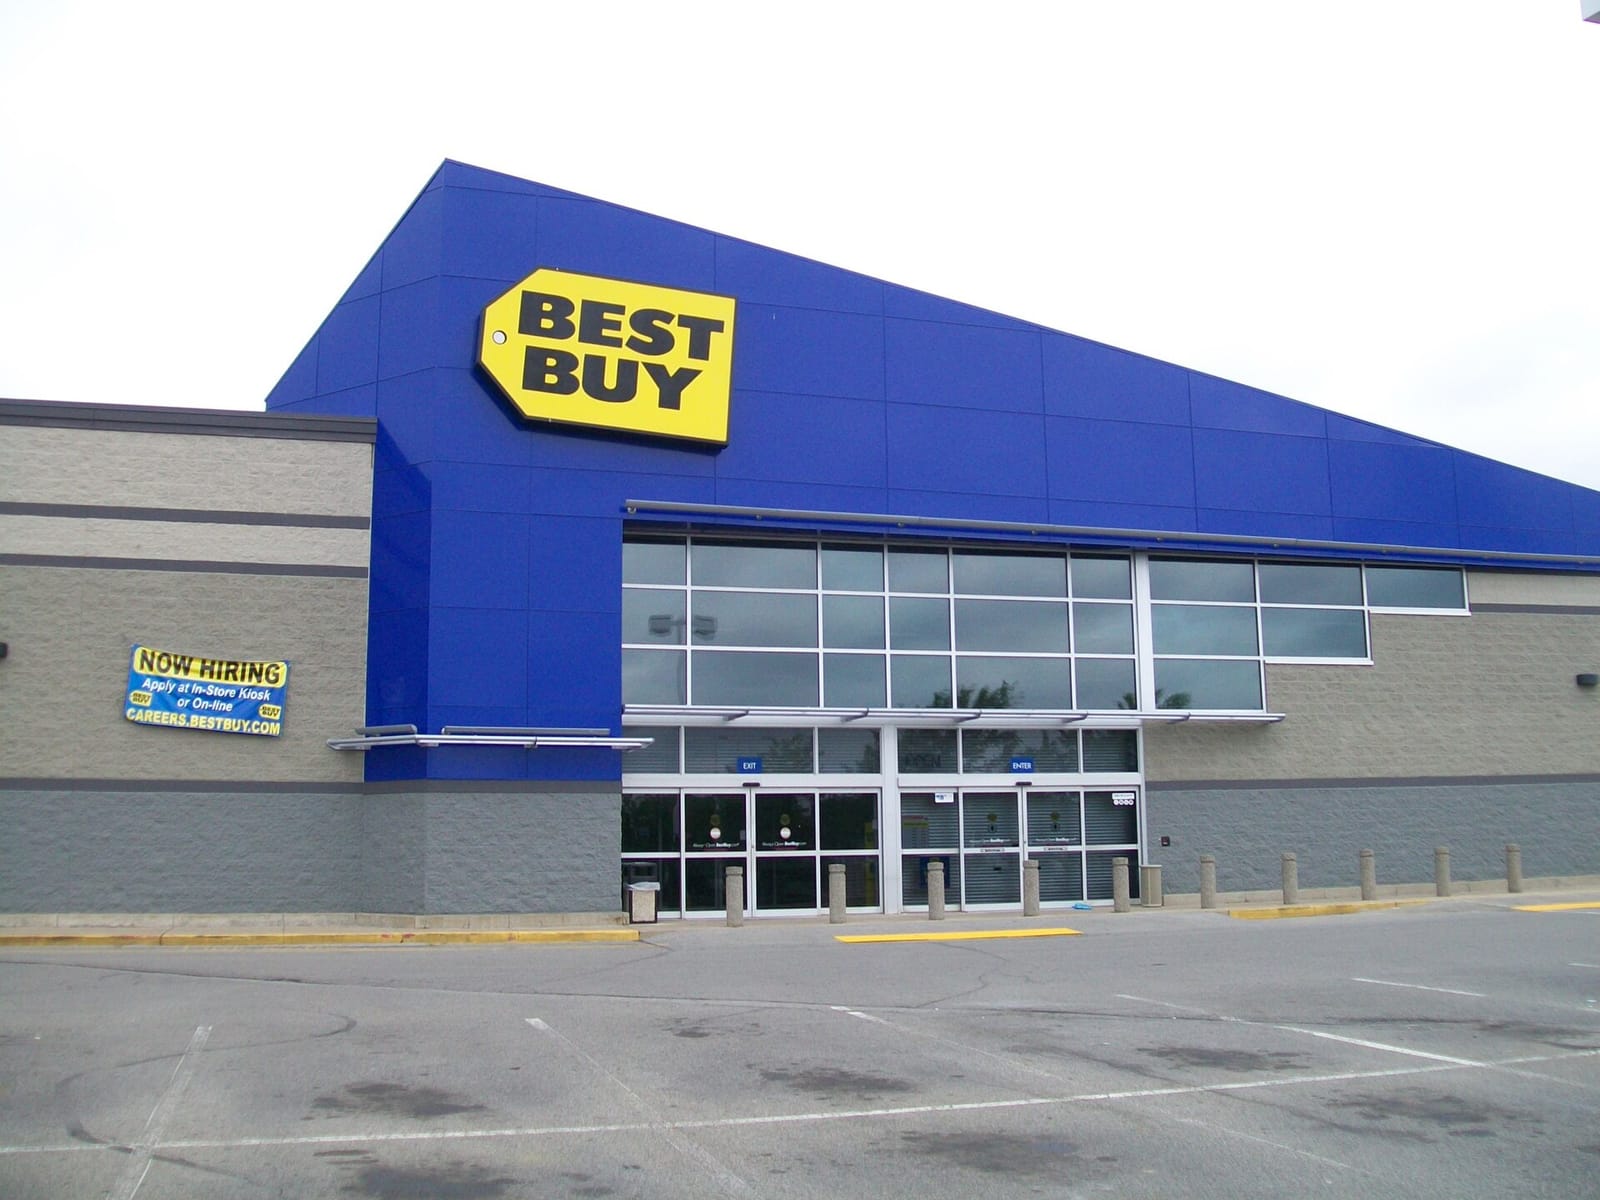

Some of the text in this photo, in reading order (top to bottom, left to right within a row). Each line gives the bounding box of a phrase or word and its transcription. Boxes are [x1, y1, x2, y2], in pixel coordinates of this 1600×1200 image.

[518, 290, 725, 361] BEST
[522, 345, 703, 411] BUY
[140, 649, 280, 684] NOW HIRING
[142, 678, 271, 701] Apply at In-Store Kiosk
[177, 697, 233, 712] or On-line
[126, 708, 281, 736] CAREERS.BESTBUY.COM
[743, 762, 756, 770] EXIT
[1012, 762, 1032, 770] ENTER
